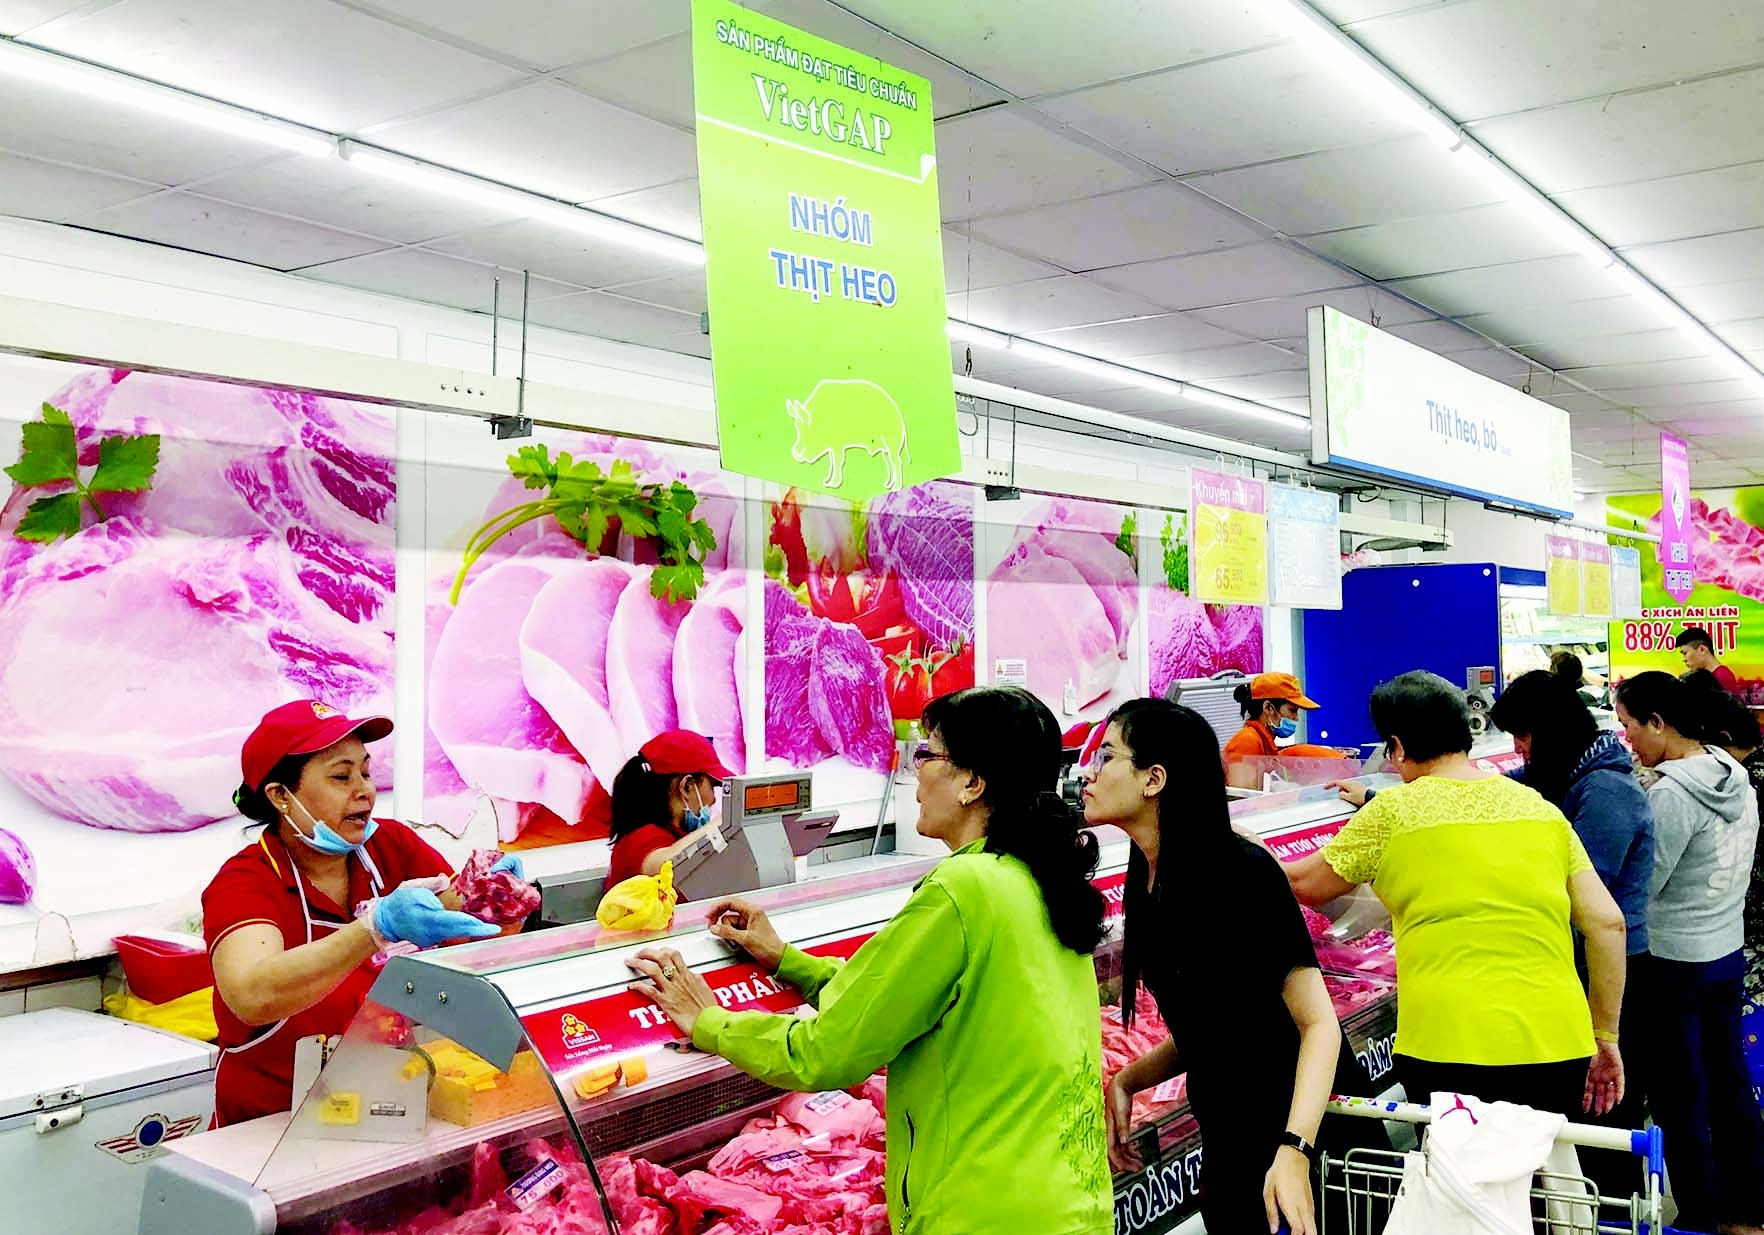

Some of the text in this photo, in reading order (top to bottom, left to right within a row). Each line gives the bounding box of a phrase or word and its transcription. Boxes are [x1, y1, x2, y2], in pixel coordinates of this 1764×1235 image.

[715, 18, 751, 53] SẢN
[800, 51, 833, 82] ĐẠT
[833, 64, 867, 93] TIÊU
[868, 80, 918, 110] CHUẨN
[751, 73, 893, 155] VietGAP
[789, 194, 873, 246] NHÓM
[769, 249, 897, 307] THỊT HEO
[1425, 399, 1453, 446] Thịt
[1482, 418, 1497, 452] bò
[1624, 620, 1739, 656] 88% ỊT
[568, 1034, 596, 1045] VISSAN
